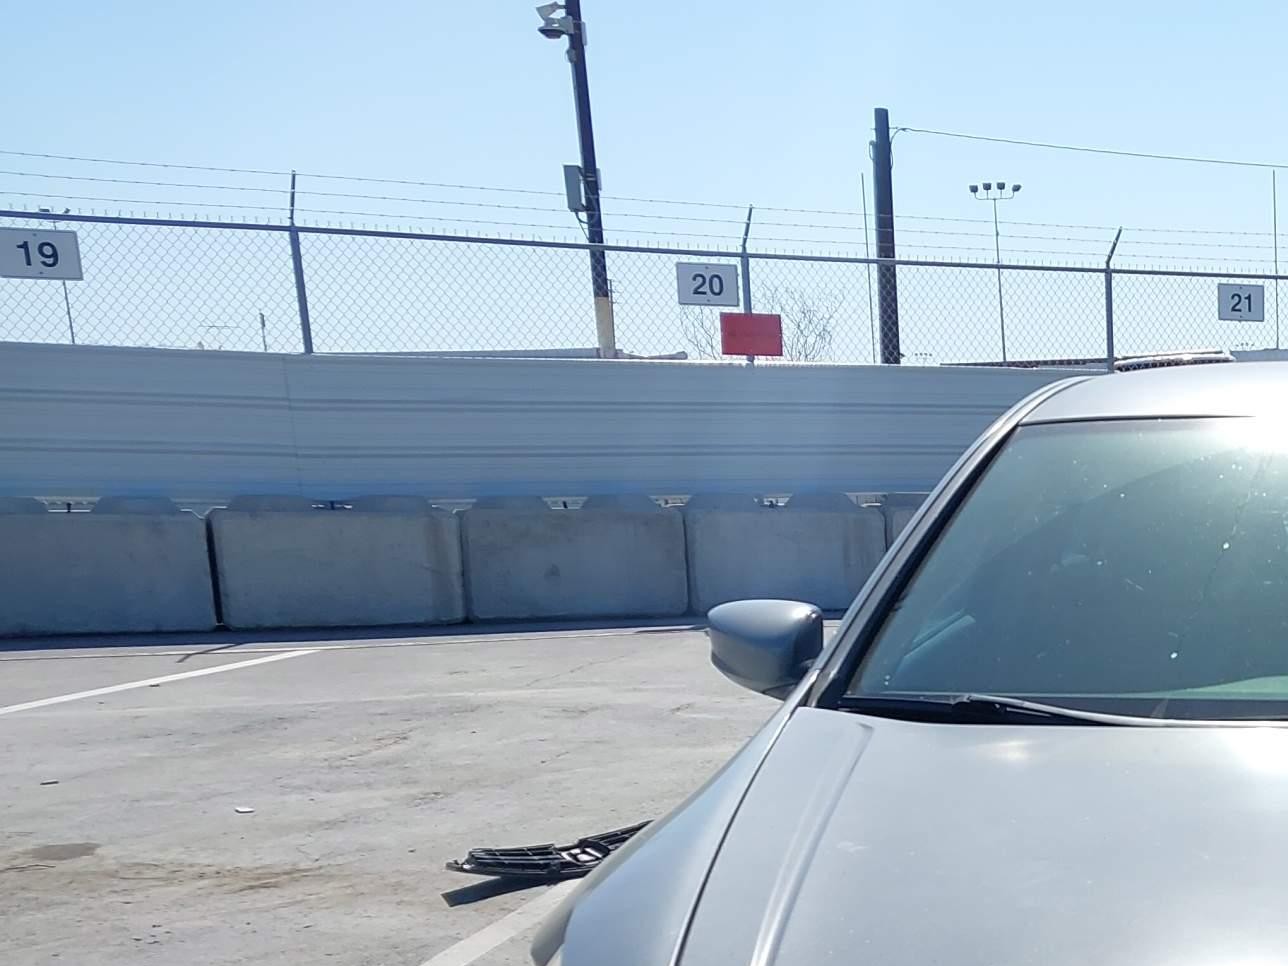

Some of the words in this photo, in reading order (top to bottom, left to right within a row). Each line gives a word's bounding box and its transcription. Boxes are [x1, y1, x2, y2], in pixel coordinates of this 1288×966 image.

[16, 240, 59, 268] 19
[691, 273, 726, 296] 20
[1230, 293, 1252, 313] 21
